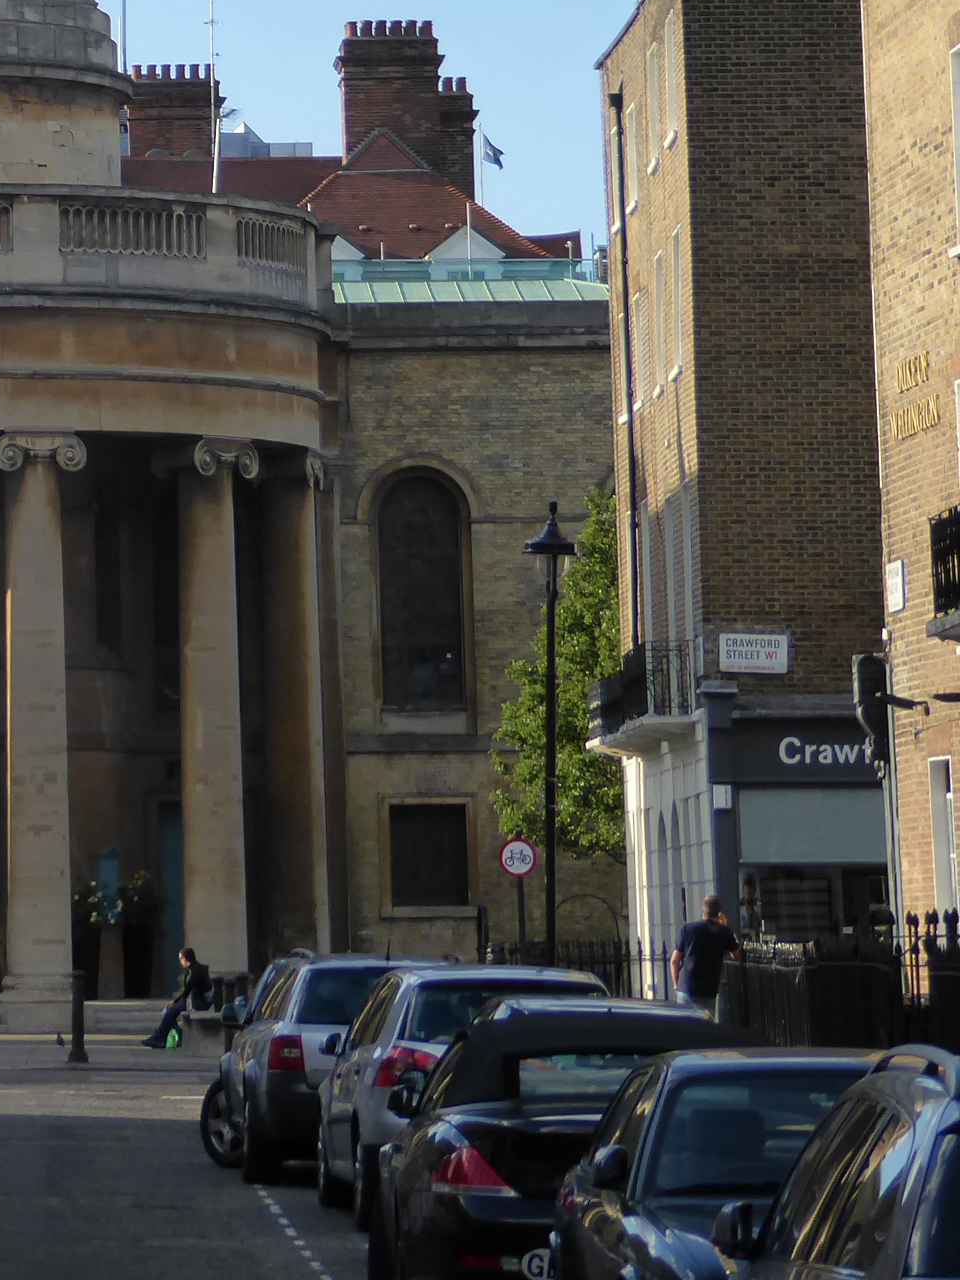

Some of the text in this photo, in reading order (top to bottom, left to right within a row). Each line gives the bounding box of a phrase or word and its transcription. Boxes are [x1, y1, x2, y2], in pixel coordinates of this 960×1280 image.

[725, 637, 780, 649] CRAWFORD
[725, 649, 778, 661] STREET W1
